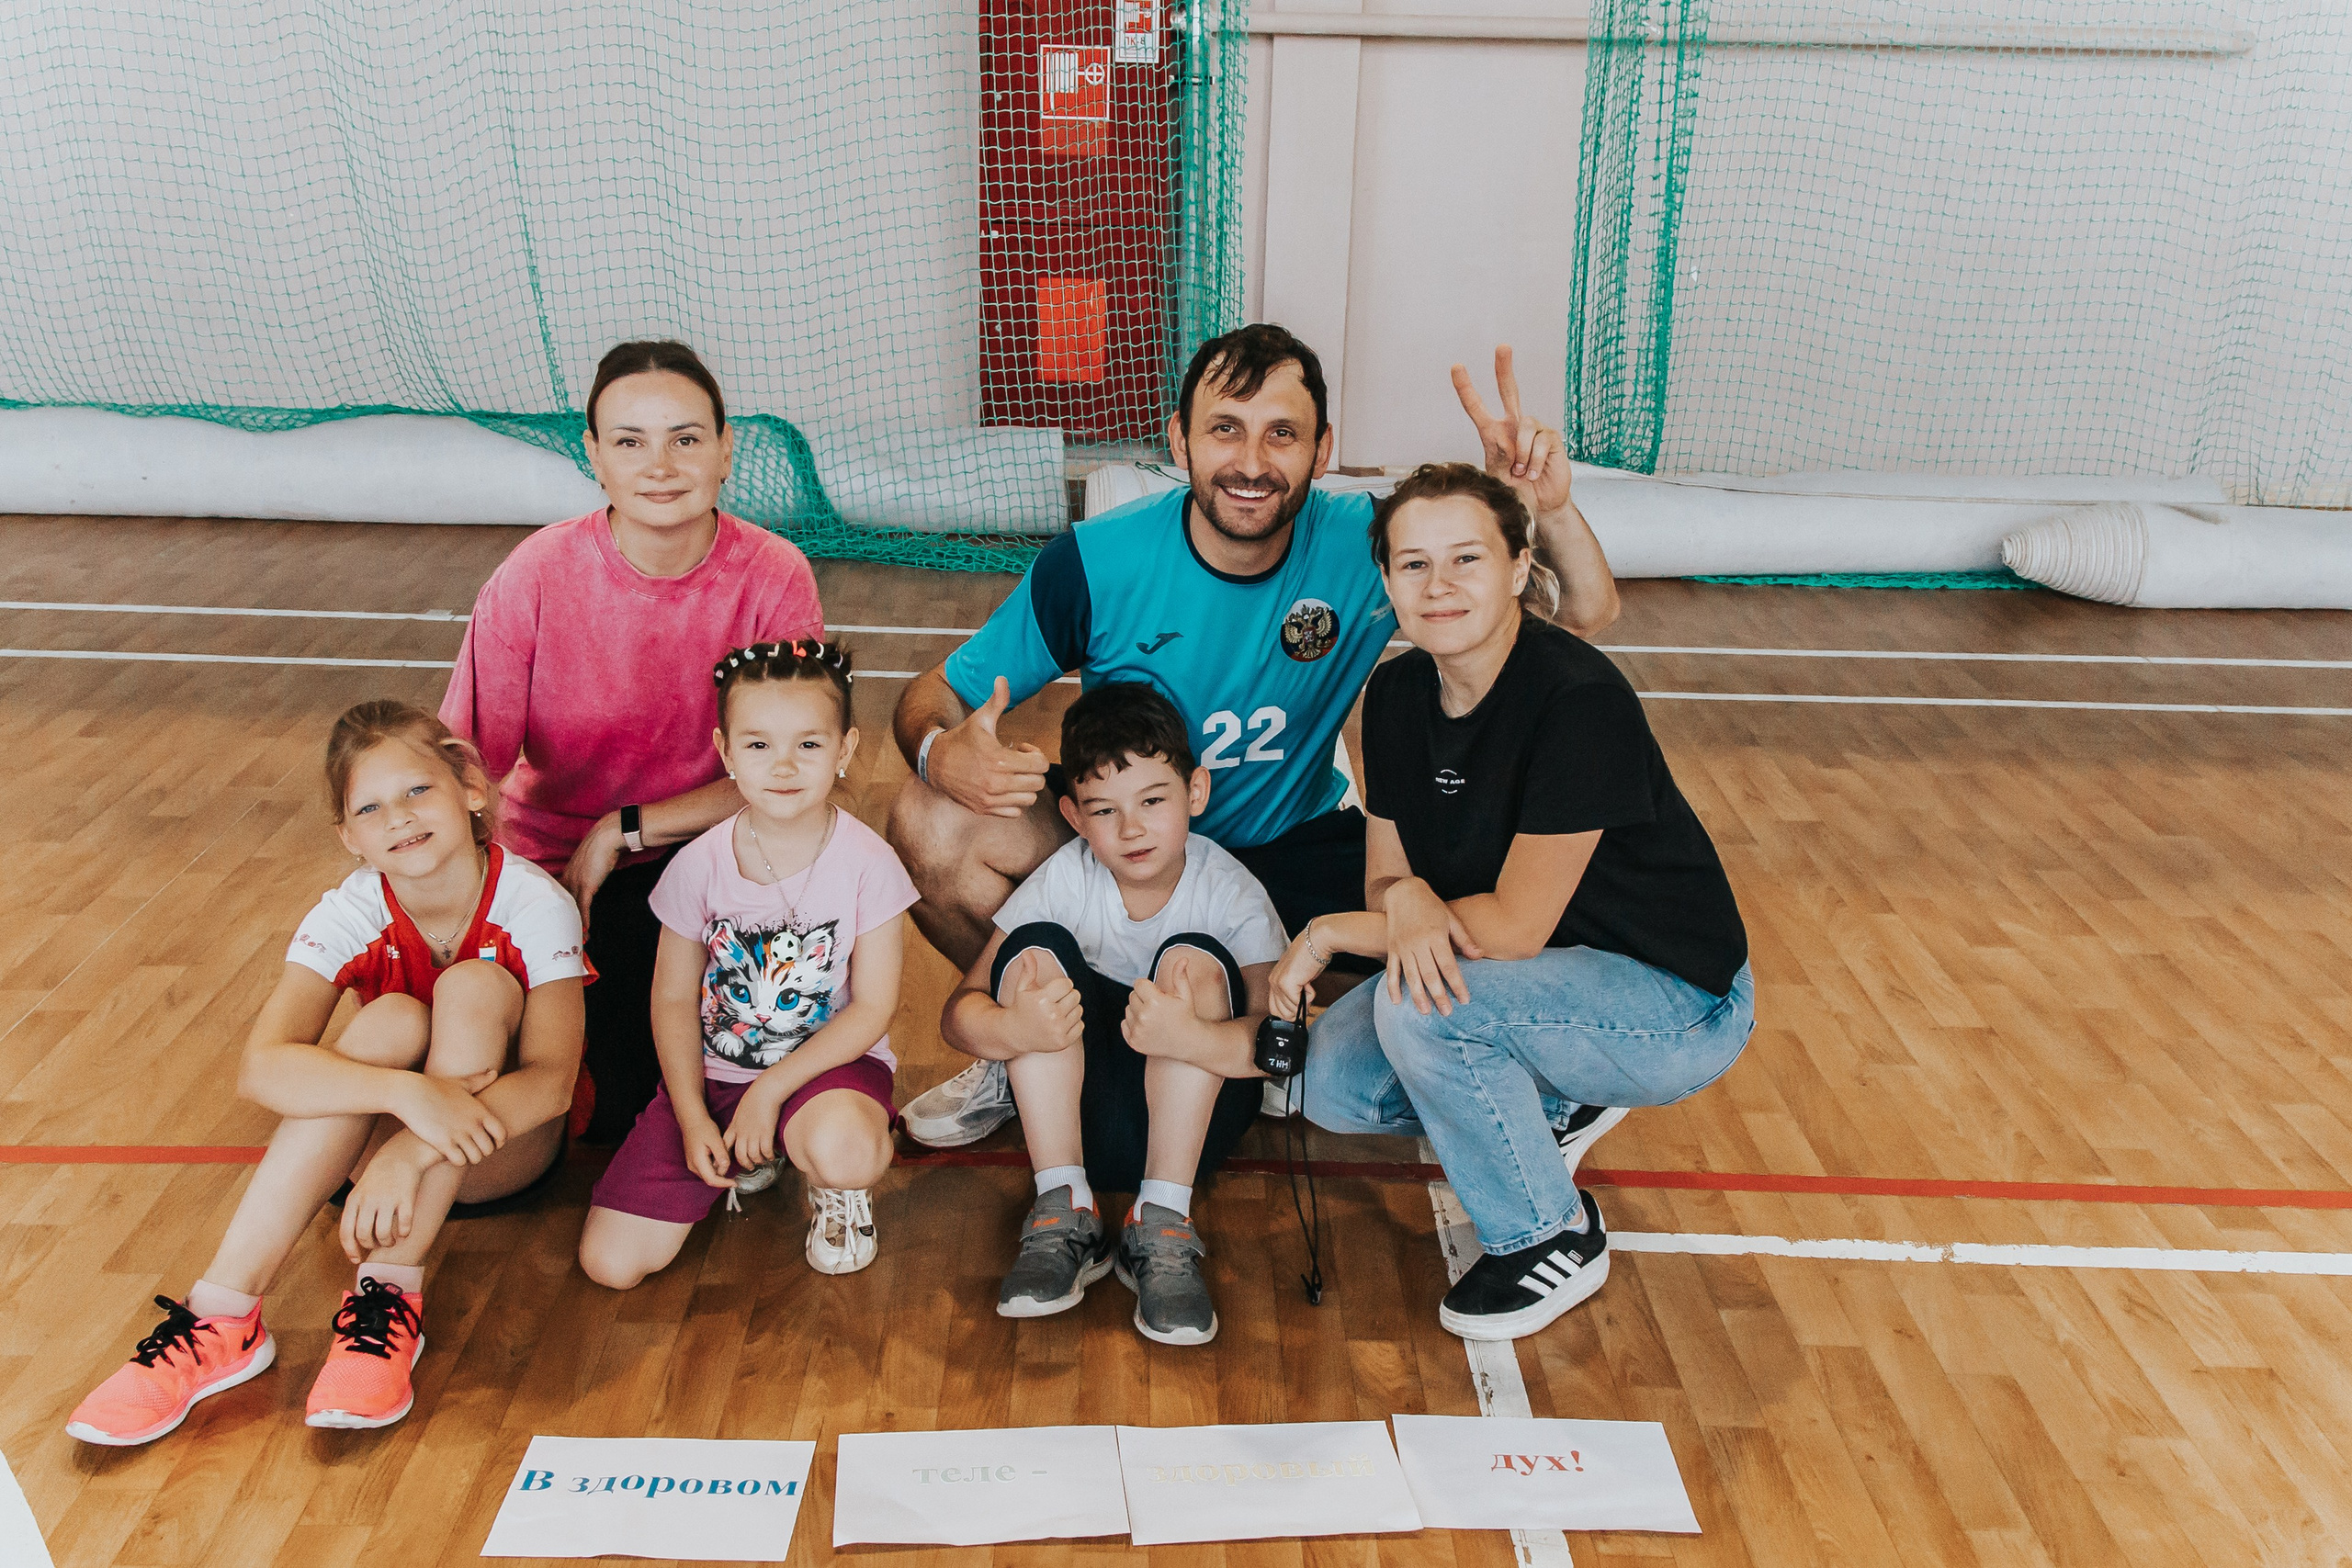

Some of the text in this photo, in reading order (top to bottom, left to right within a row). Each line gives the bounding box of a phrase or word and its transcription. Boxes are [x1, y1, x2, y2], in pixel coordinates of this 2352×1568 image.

[1201, 705, 1286, 770] 22
[912, 1464, 1016, 1484] теле
[1148, 1454, 1375, 1486] здоровый
[1491, 1450, 1584, 1476] дух!
[518, 1470, 799, 1498] В здоровом
